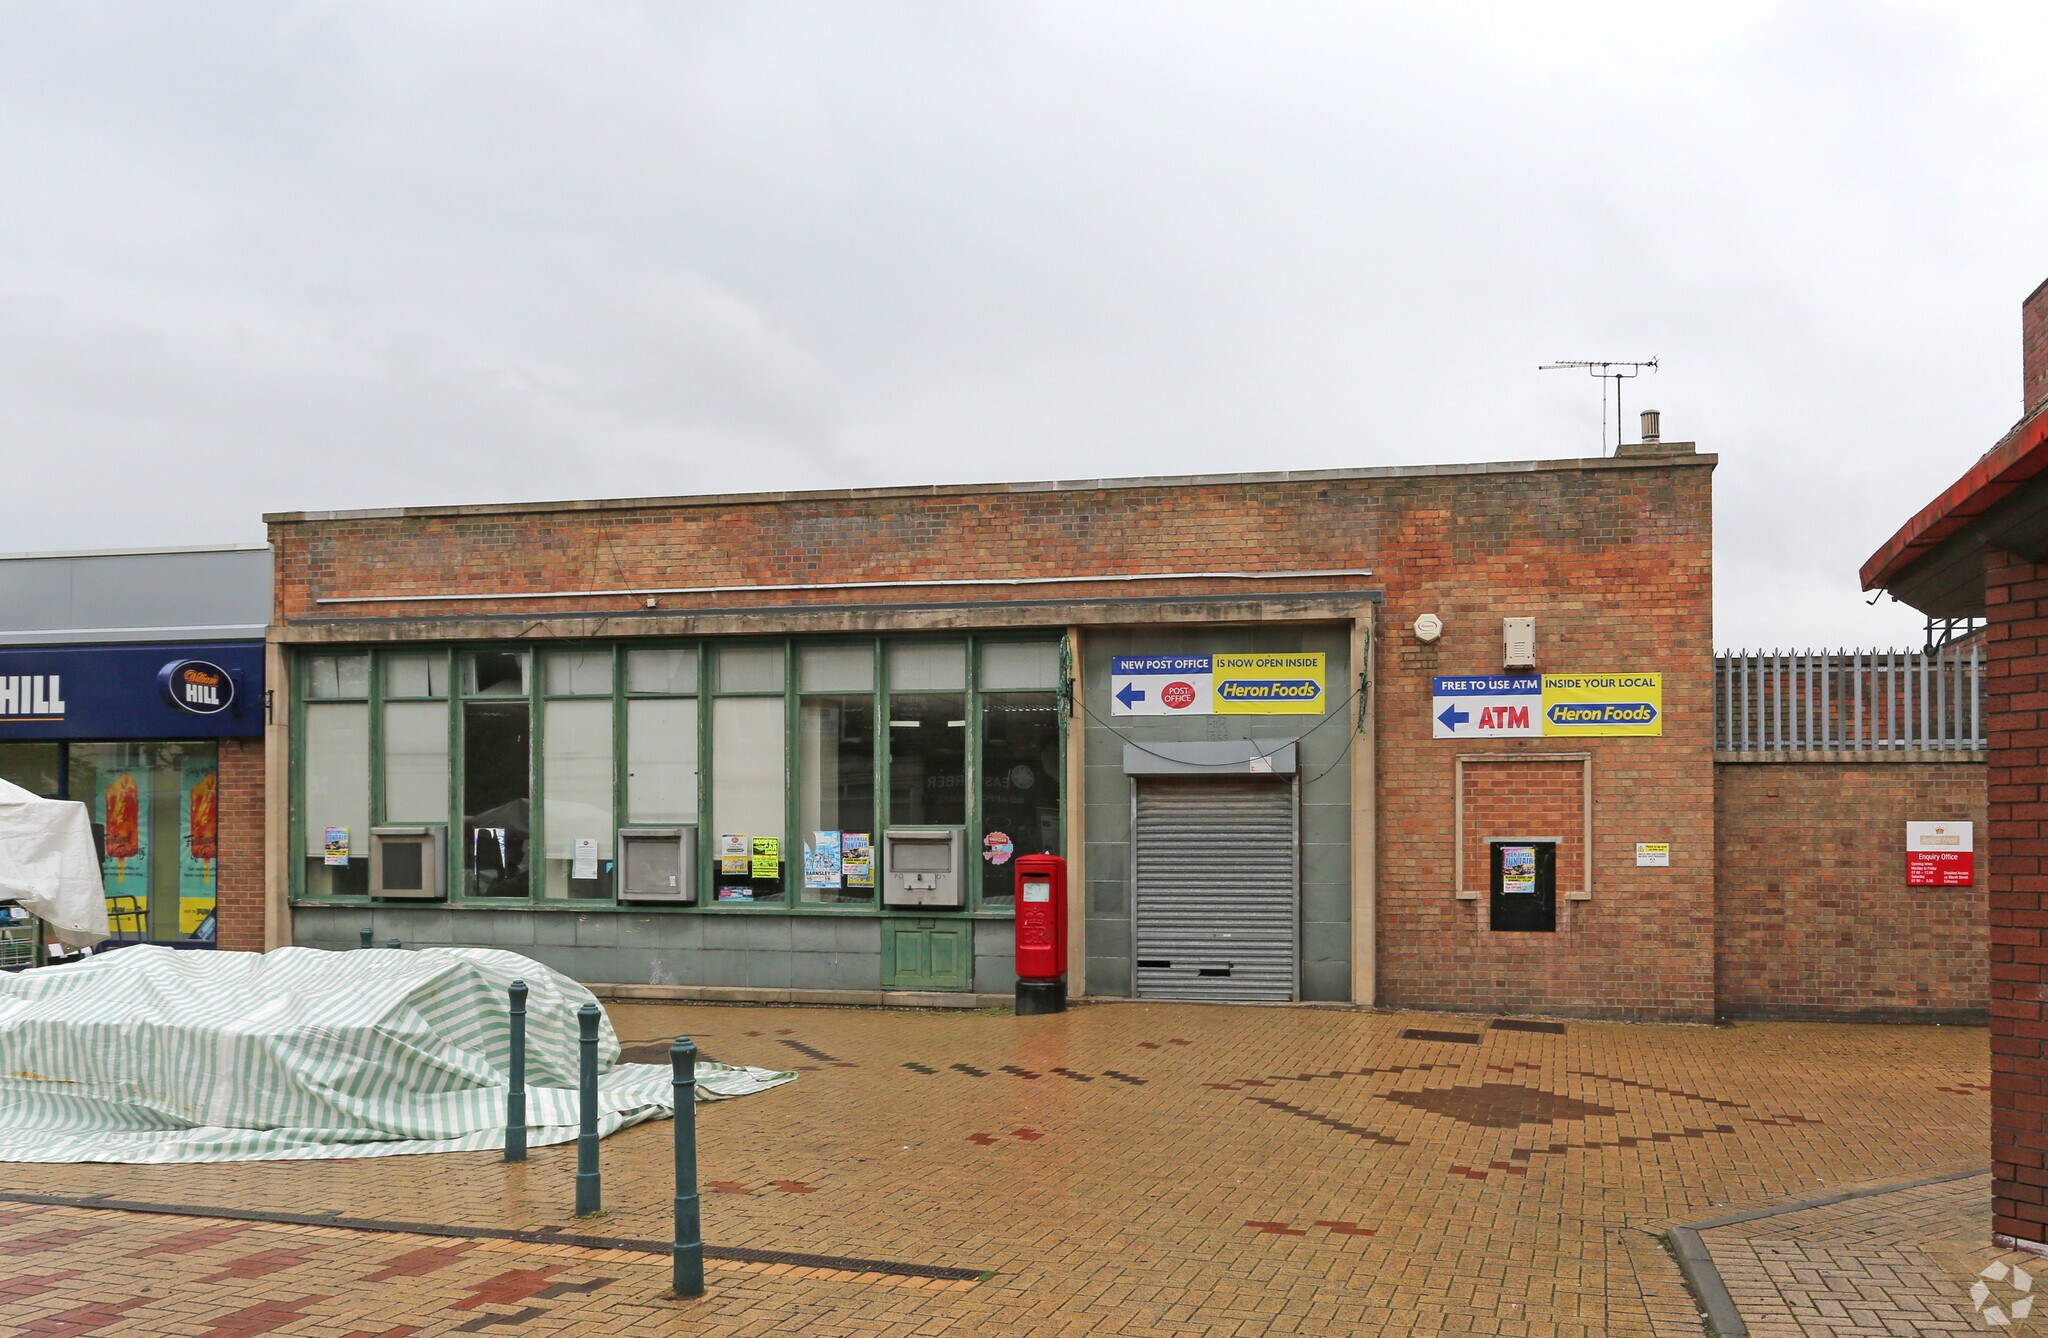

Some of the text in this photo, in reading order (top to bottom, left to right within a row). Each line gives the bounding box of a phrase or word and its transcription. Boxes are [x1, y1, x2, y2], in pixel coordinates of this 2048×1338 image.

[1121, 659, 1209, 669] NEW POST OFFICE
[1216, 658, 1318, 667] IS NOW OPEN INSIDE
[1441, 679, 1538, 690] FREE TO USE ATM
[1545, 678, 1656, 688] INSIDE YOUR LOCAL
[1168, 687, 1189, 695] POST
[1223, 681, 1315, 697] Heron Foods
[0, 675, 65, 715] HILL
[185, 684, 220, 705] HILL
[1164, 694, 1192, 703] OFFICE
[1478, 706, 1530, 729] ATM
[1552, 705, 1652, 721] Heron Foods
[1919, 853, 1940, 861] Enquiry
